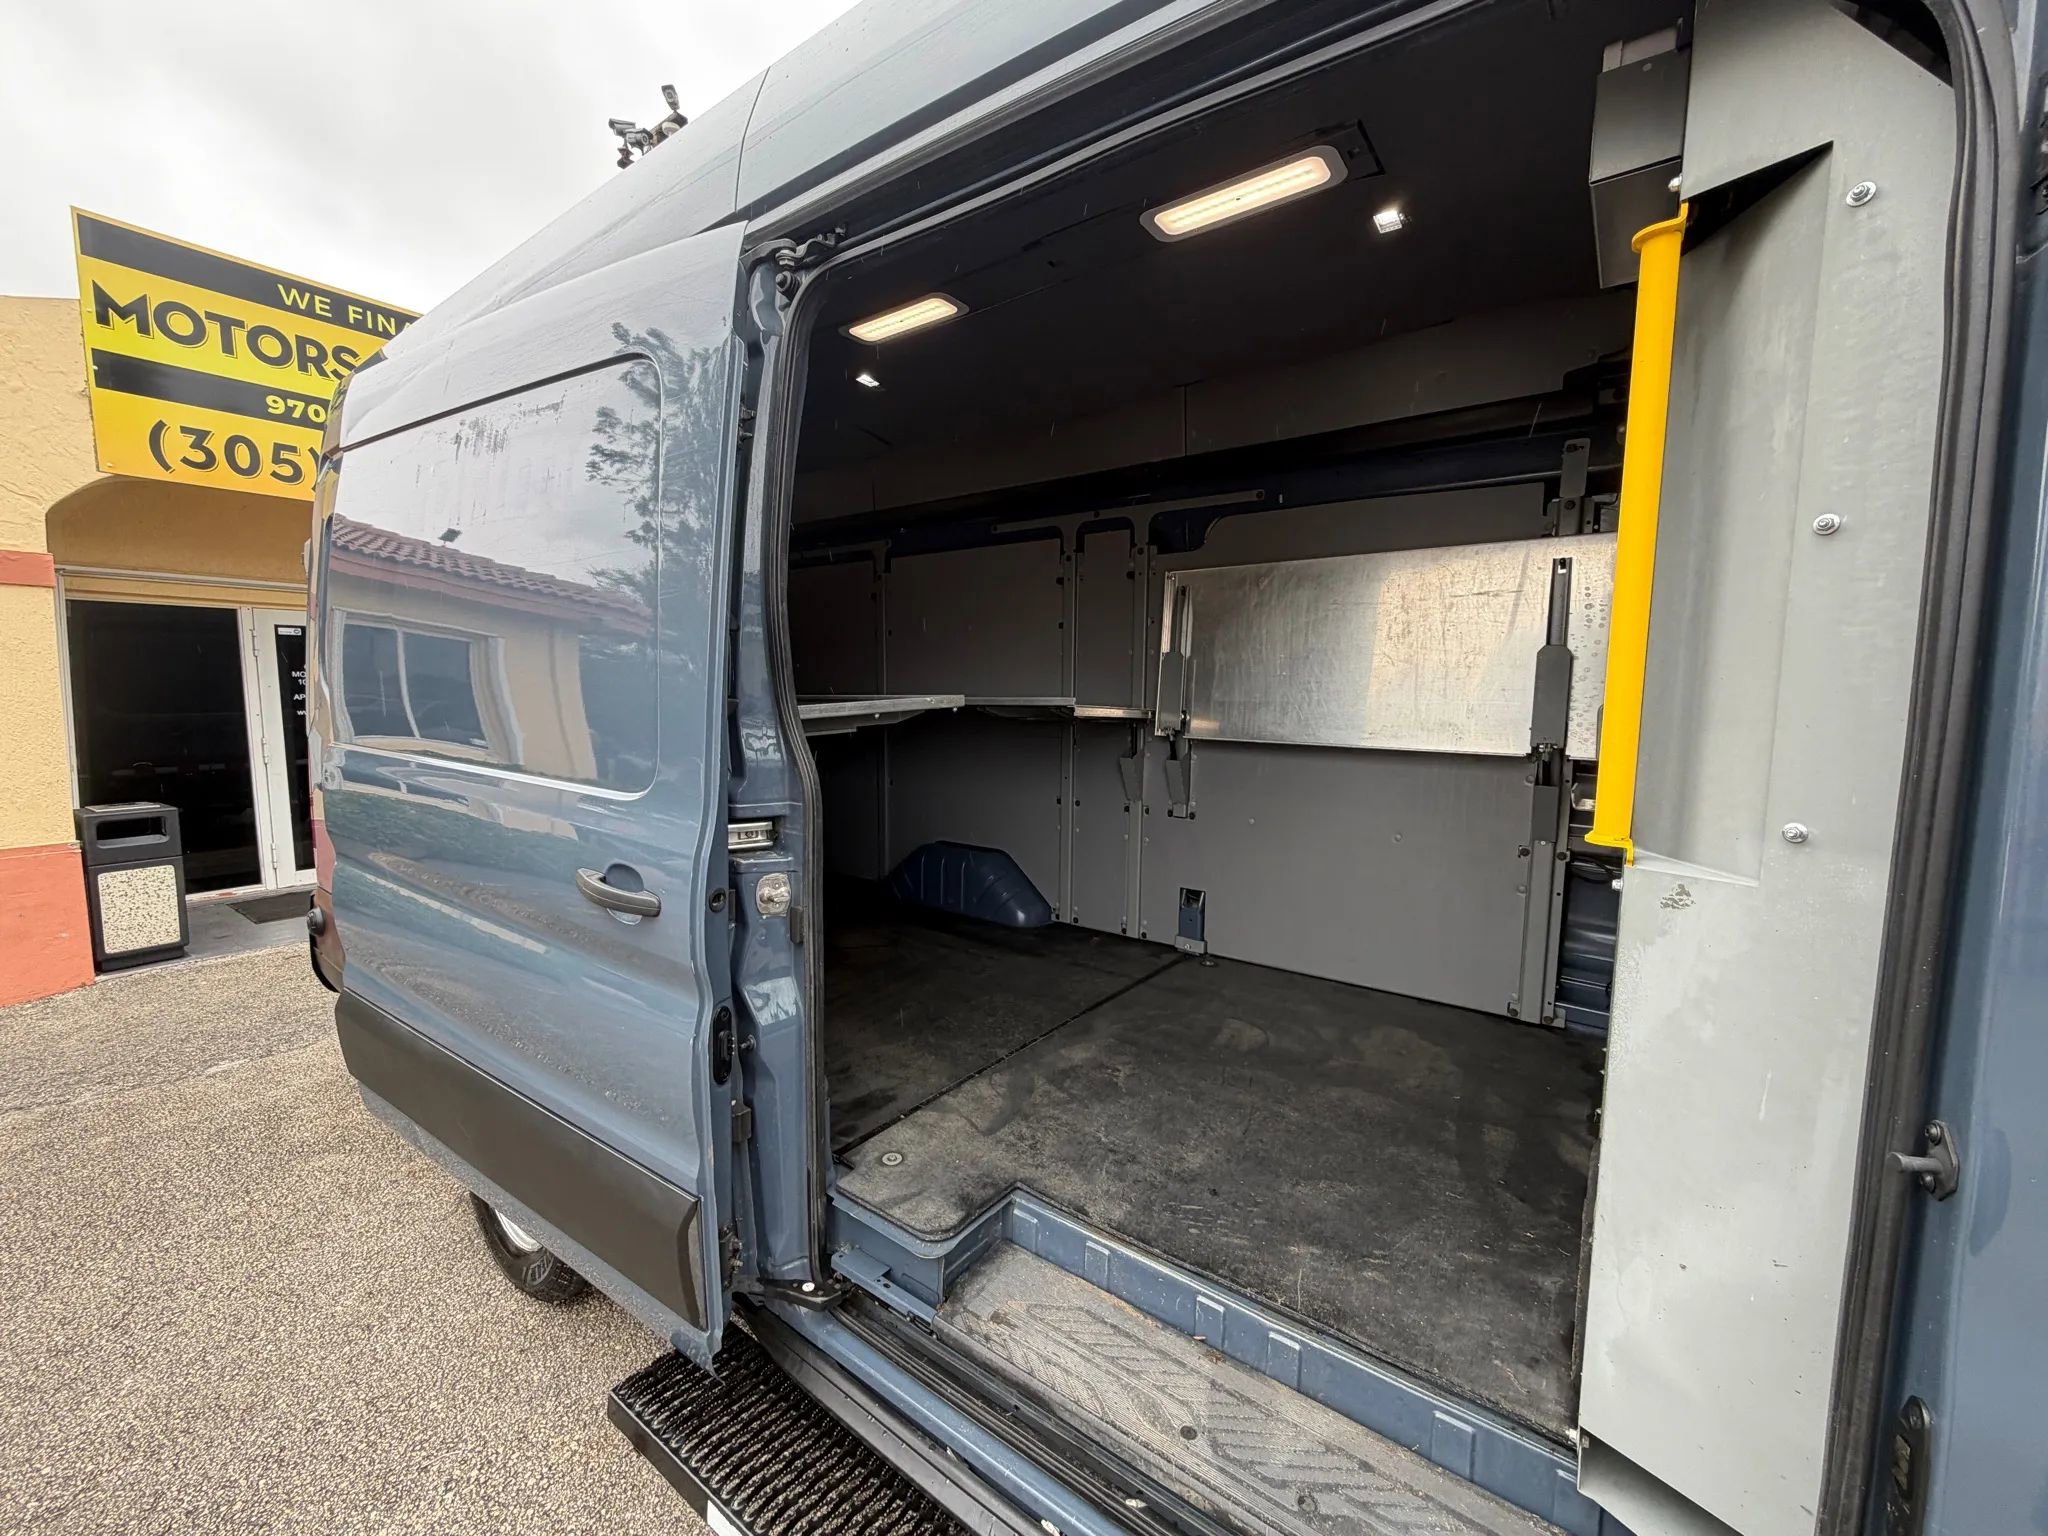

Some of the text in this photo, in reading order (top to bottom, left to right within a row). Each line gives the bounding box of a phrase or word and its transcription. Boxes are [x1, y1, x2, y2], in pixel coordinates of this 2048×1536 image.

[92, 280, 361, 382] MOTORS
[277, 284, 411, 336] WE FIN
[265, 395, 327, 423] 970
